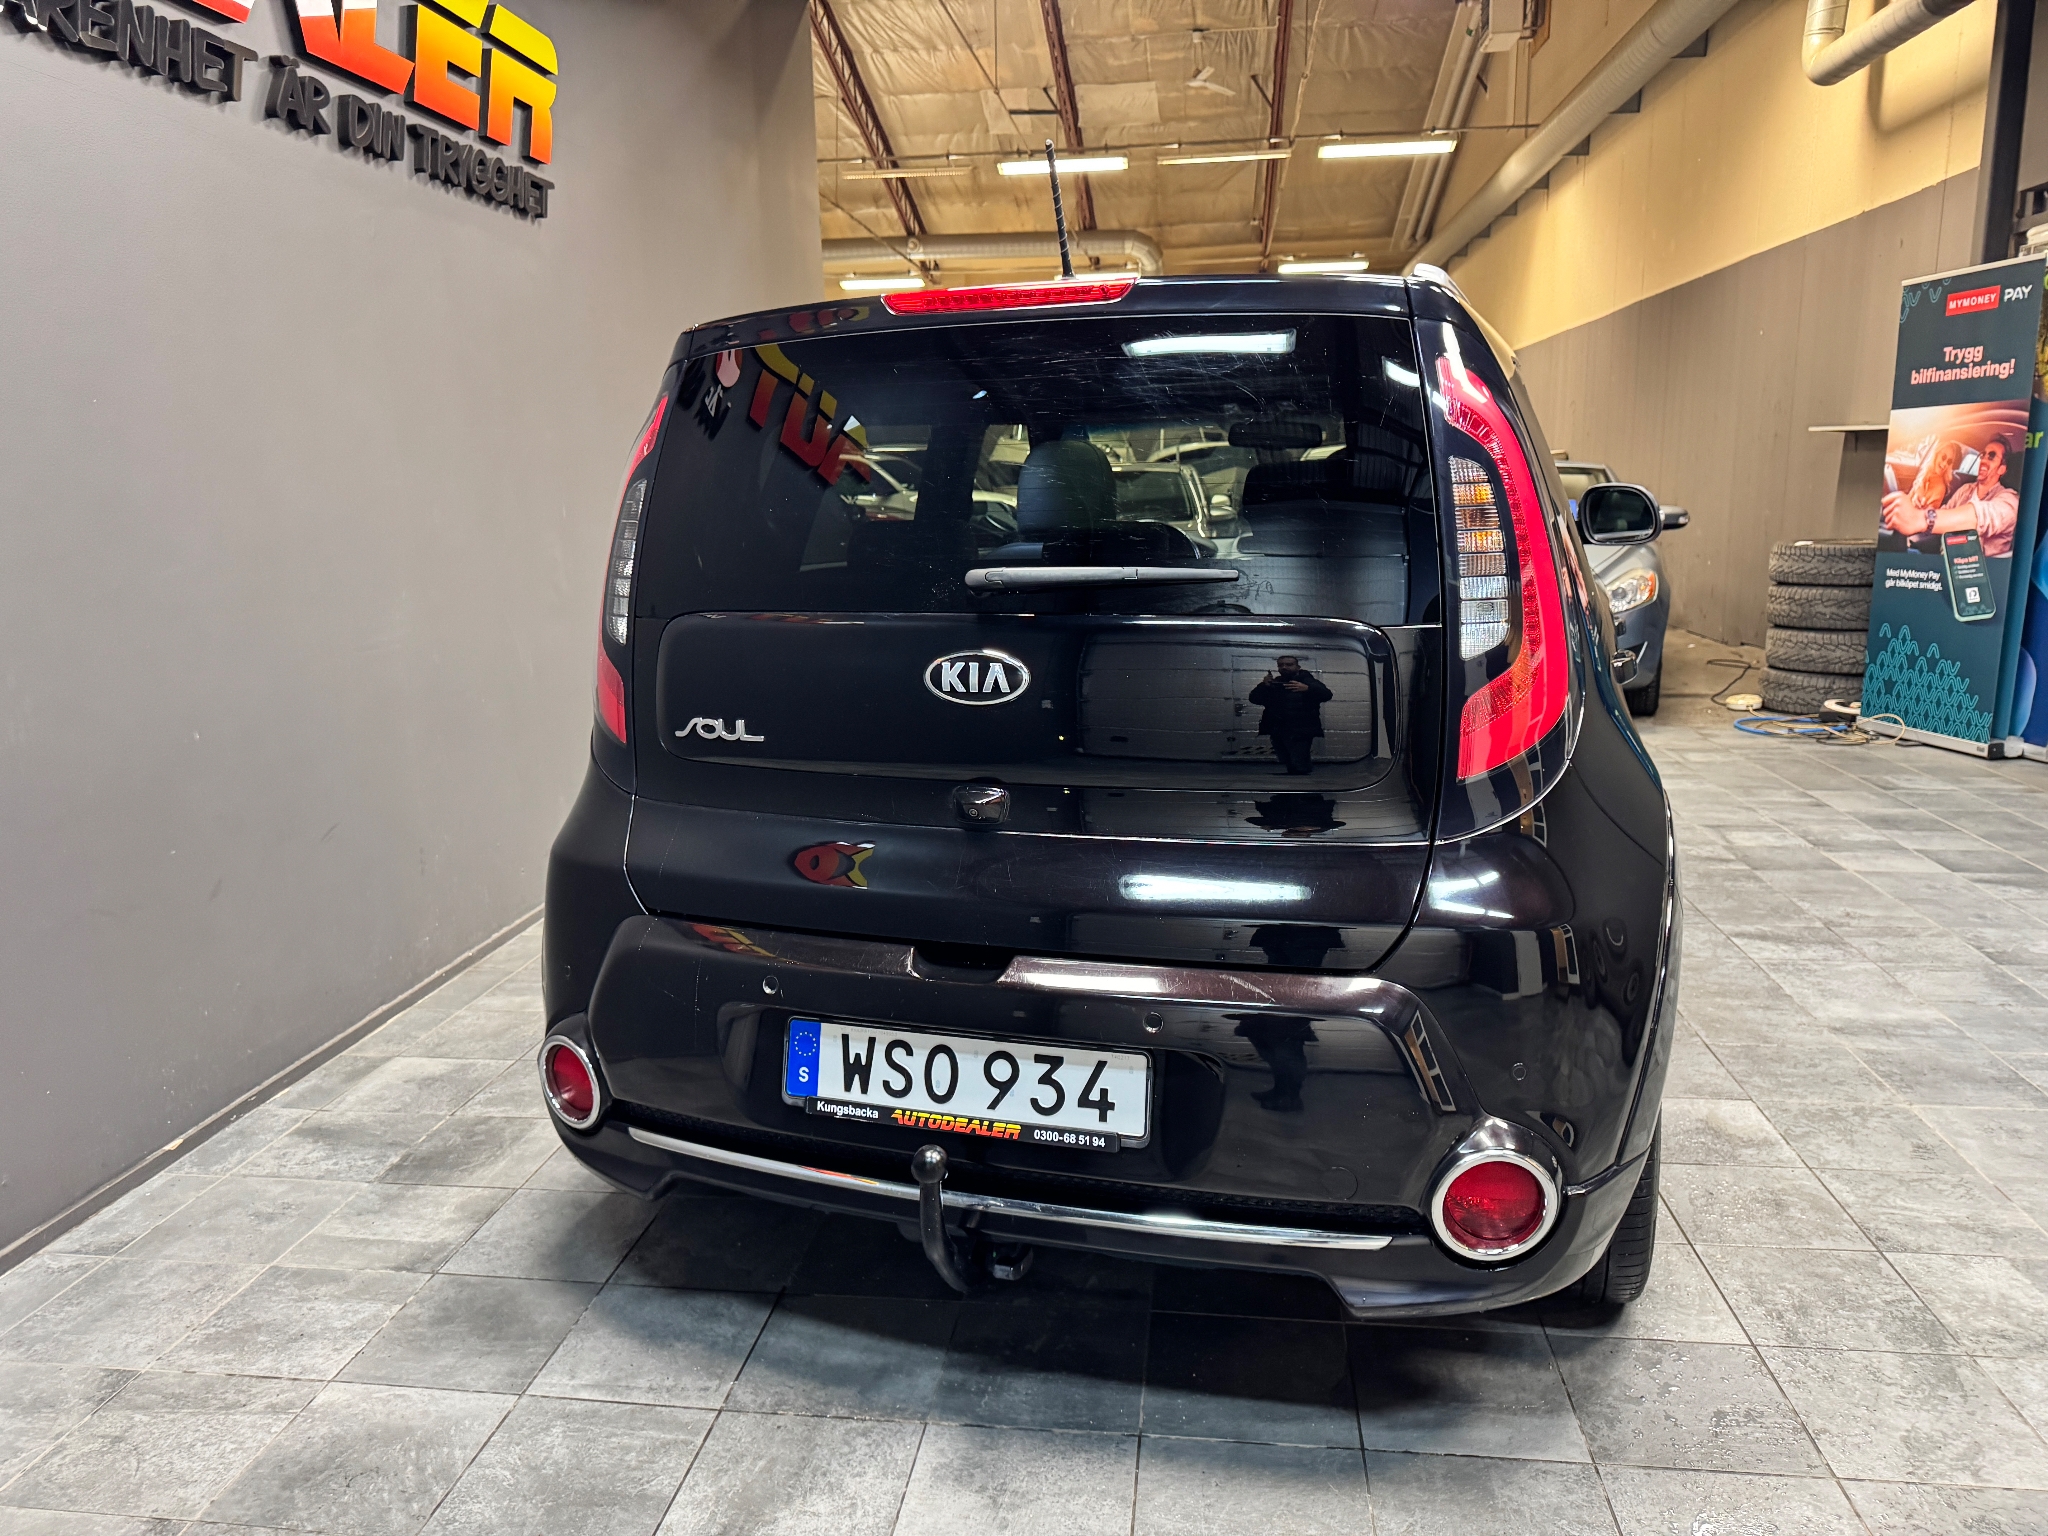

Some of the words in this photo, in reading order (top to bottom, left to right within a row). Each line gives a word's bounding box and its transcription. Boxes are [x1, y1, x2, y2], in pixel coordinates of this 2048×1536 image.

[267, 55, 331, 135] ÄR
[341, 94, 406, 161] DIN
[408, 123, 555, 218] TRYGGHET
[1948, 292, 1997, 310] MYMONEY
[2003, 284, 2033, 302] PAY
[1943, 345, 1984, 365] Trygg
[1910, 358, 2016, 385] bilfinansiering!
[1928, 570, 1941, 581] Pay
[941, 661, 1011, 693] KIA
[674, 716, 765, 742] SOUL
[798, 1066, 810, 1083] S
[841, 1033, 959, 1105] WSO
[983, 1050, 1116, 1123] 934
[817, 1100, 879, 1119] Kungsbacka
[891, 1109, 1022, 1140] AUTODEALER
[1033, 1129, 1077, 1144] 0300-68
[1078, 1134, 1091, 1146] 51
[1092, 1137, 1106, 1148] 94
